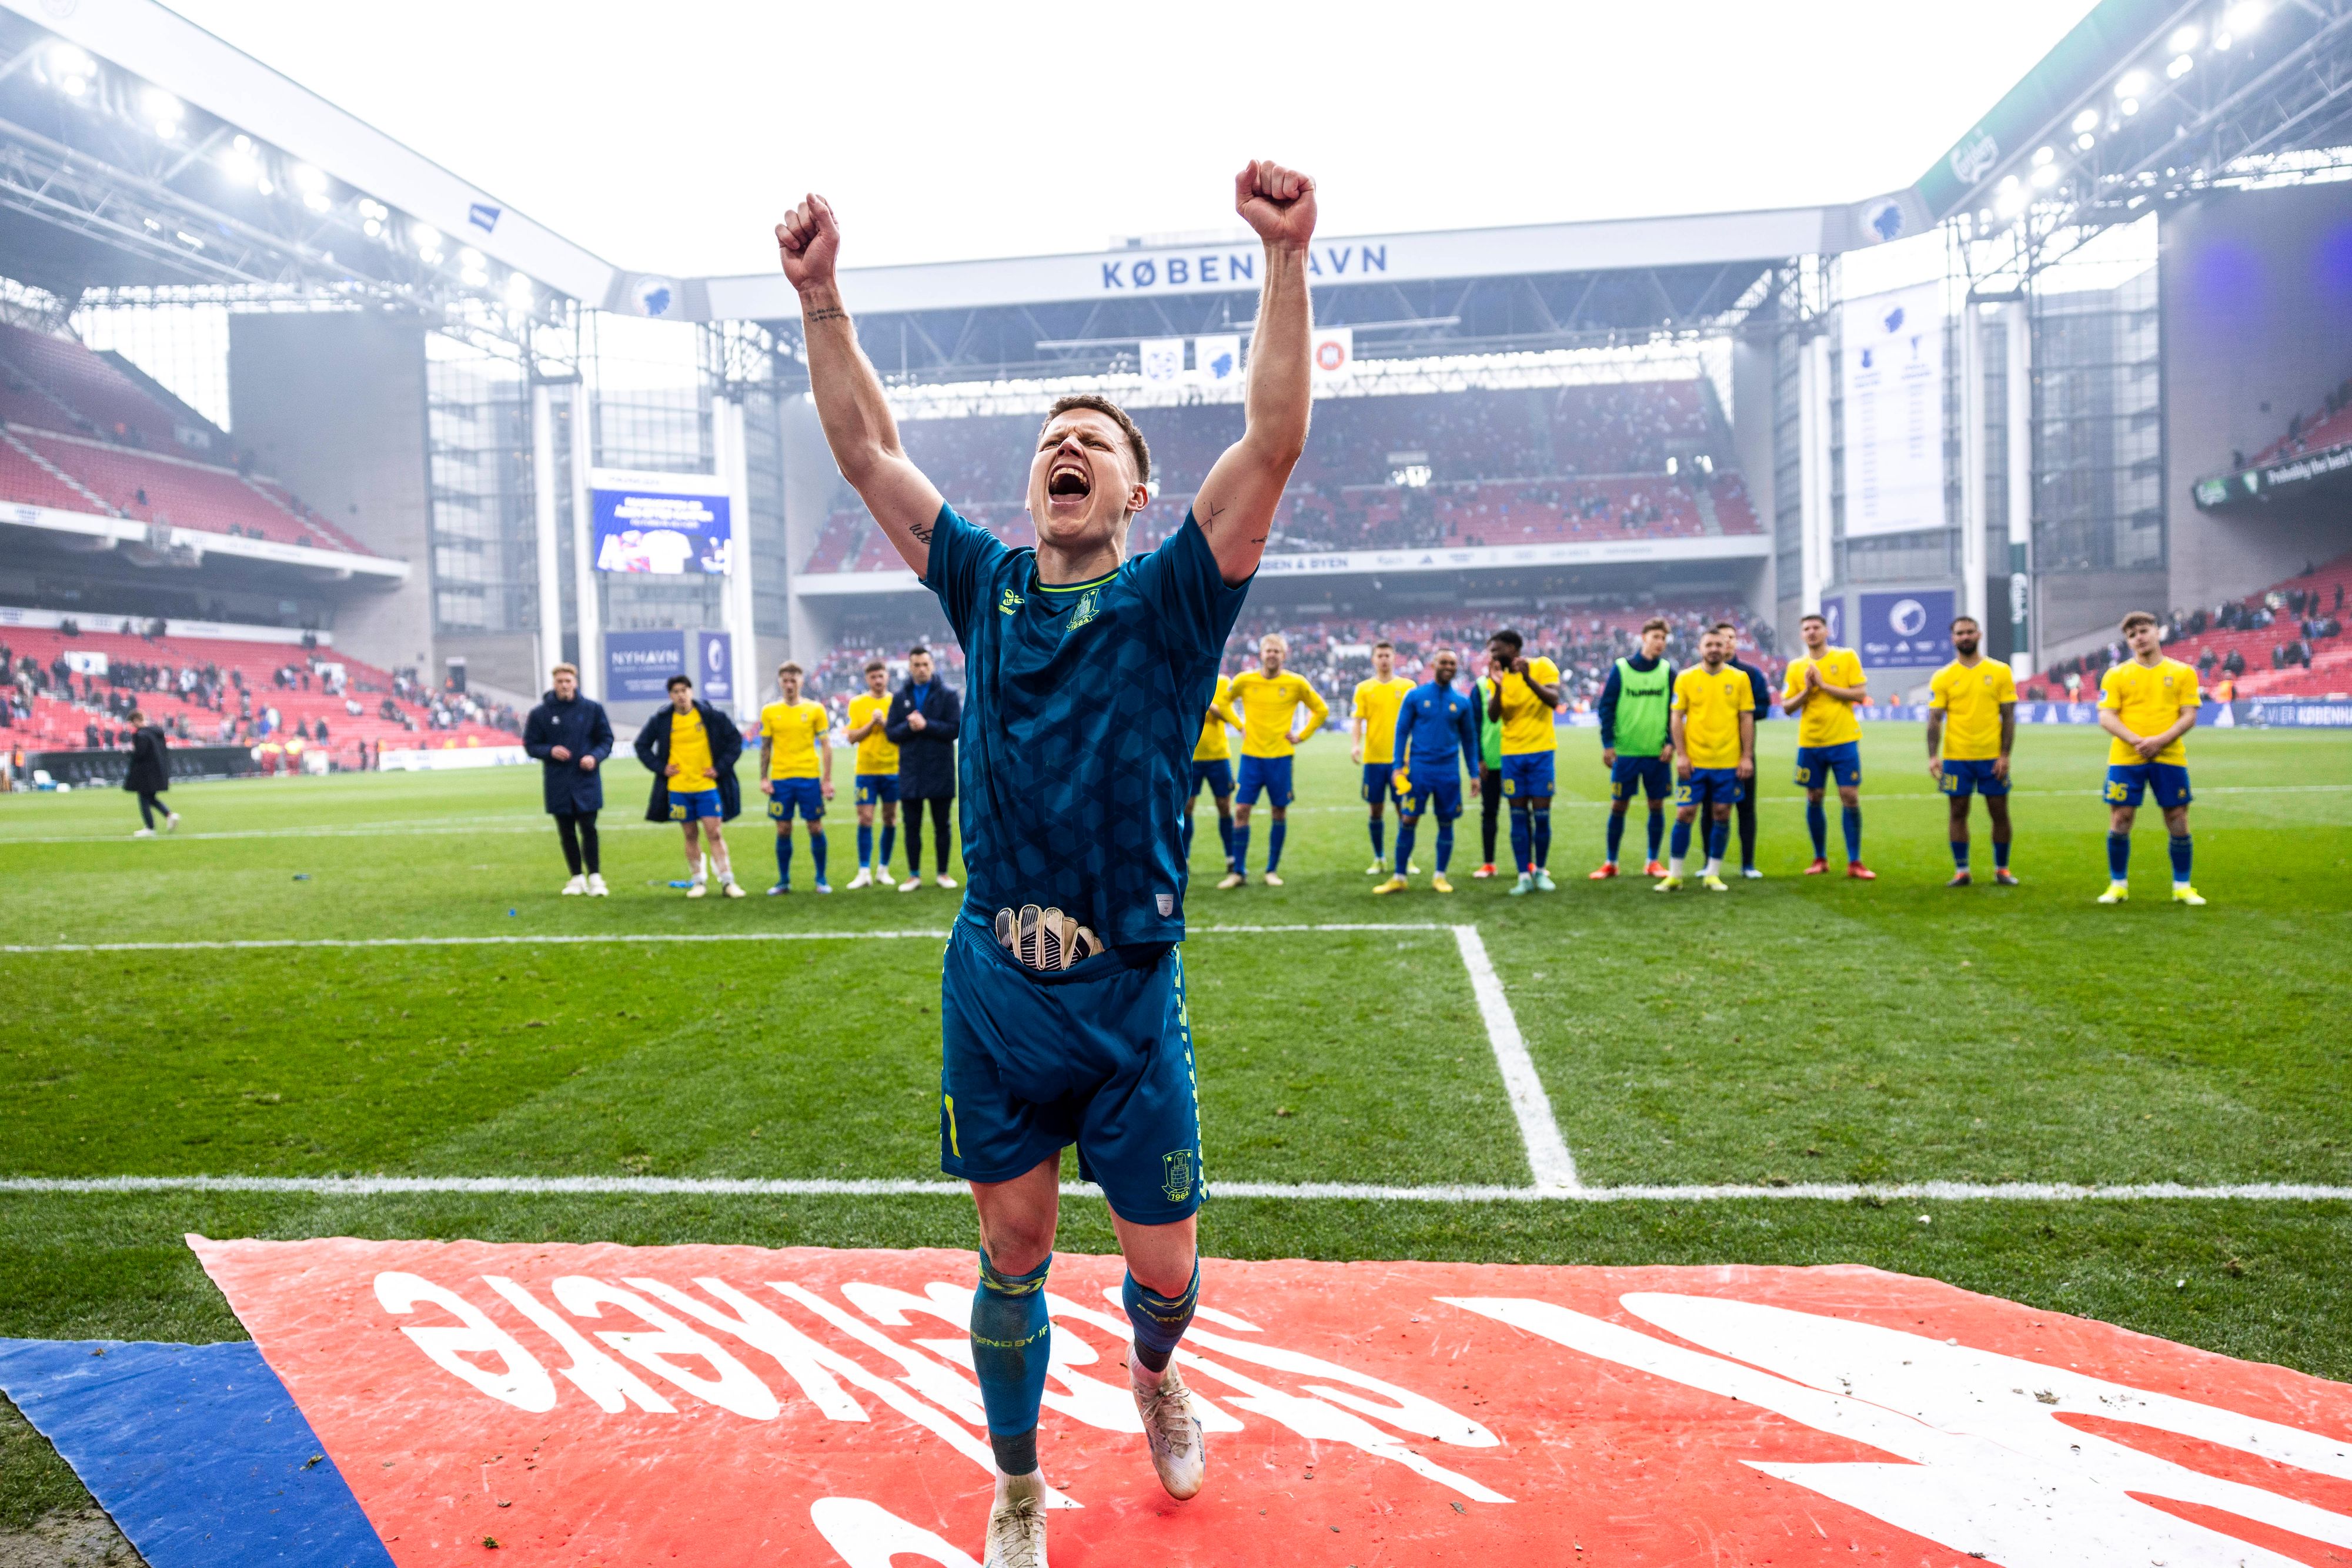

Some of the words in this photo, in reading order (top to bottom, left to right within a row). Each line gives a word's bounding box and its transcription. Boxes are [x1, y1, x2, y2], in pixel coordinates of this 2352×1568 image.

[1102, 244, 1386, 289] KØBENAVN
[612, 650, 680, 665] NYHAVN
[2107, 780, 2129, 802] 36
[944, 1094, 961, 1158] 1
[1171, 1191, 1189, 1201] 1964
